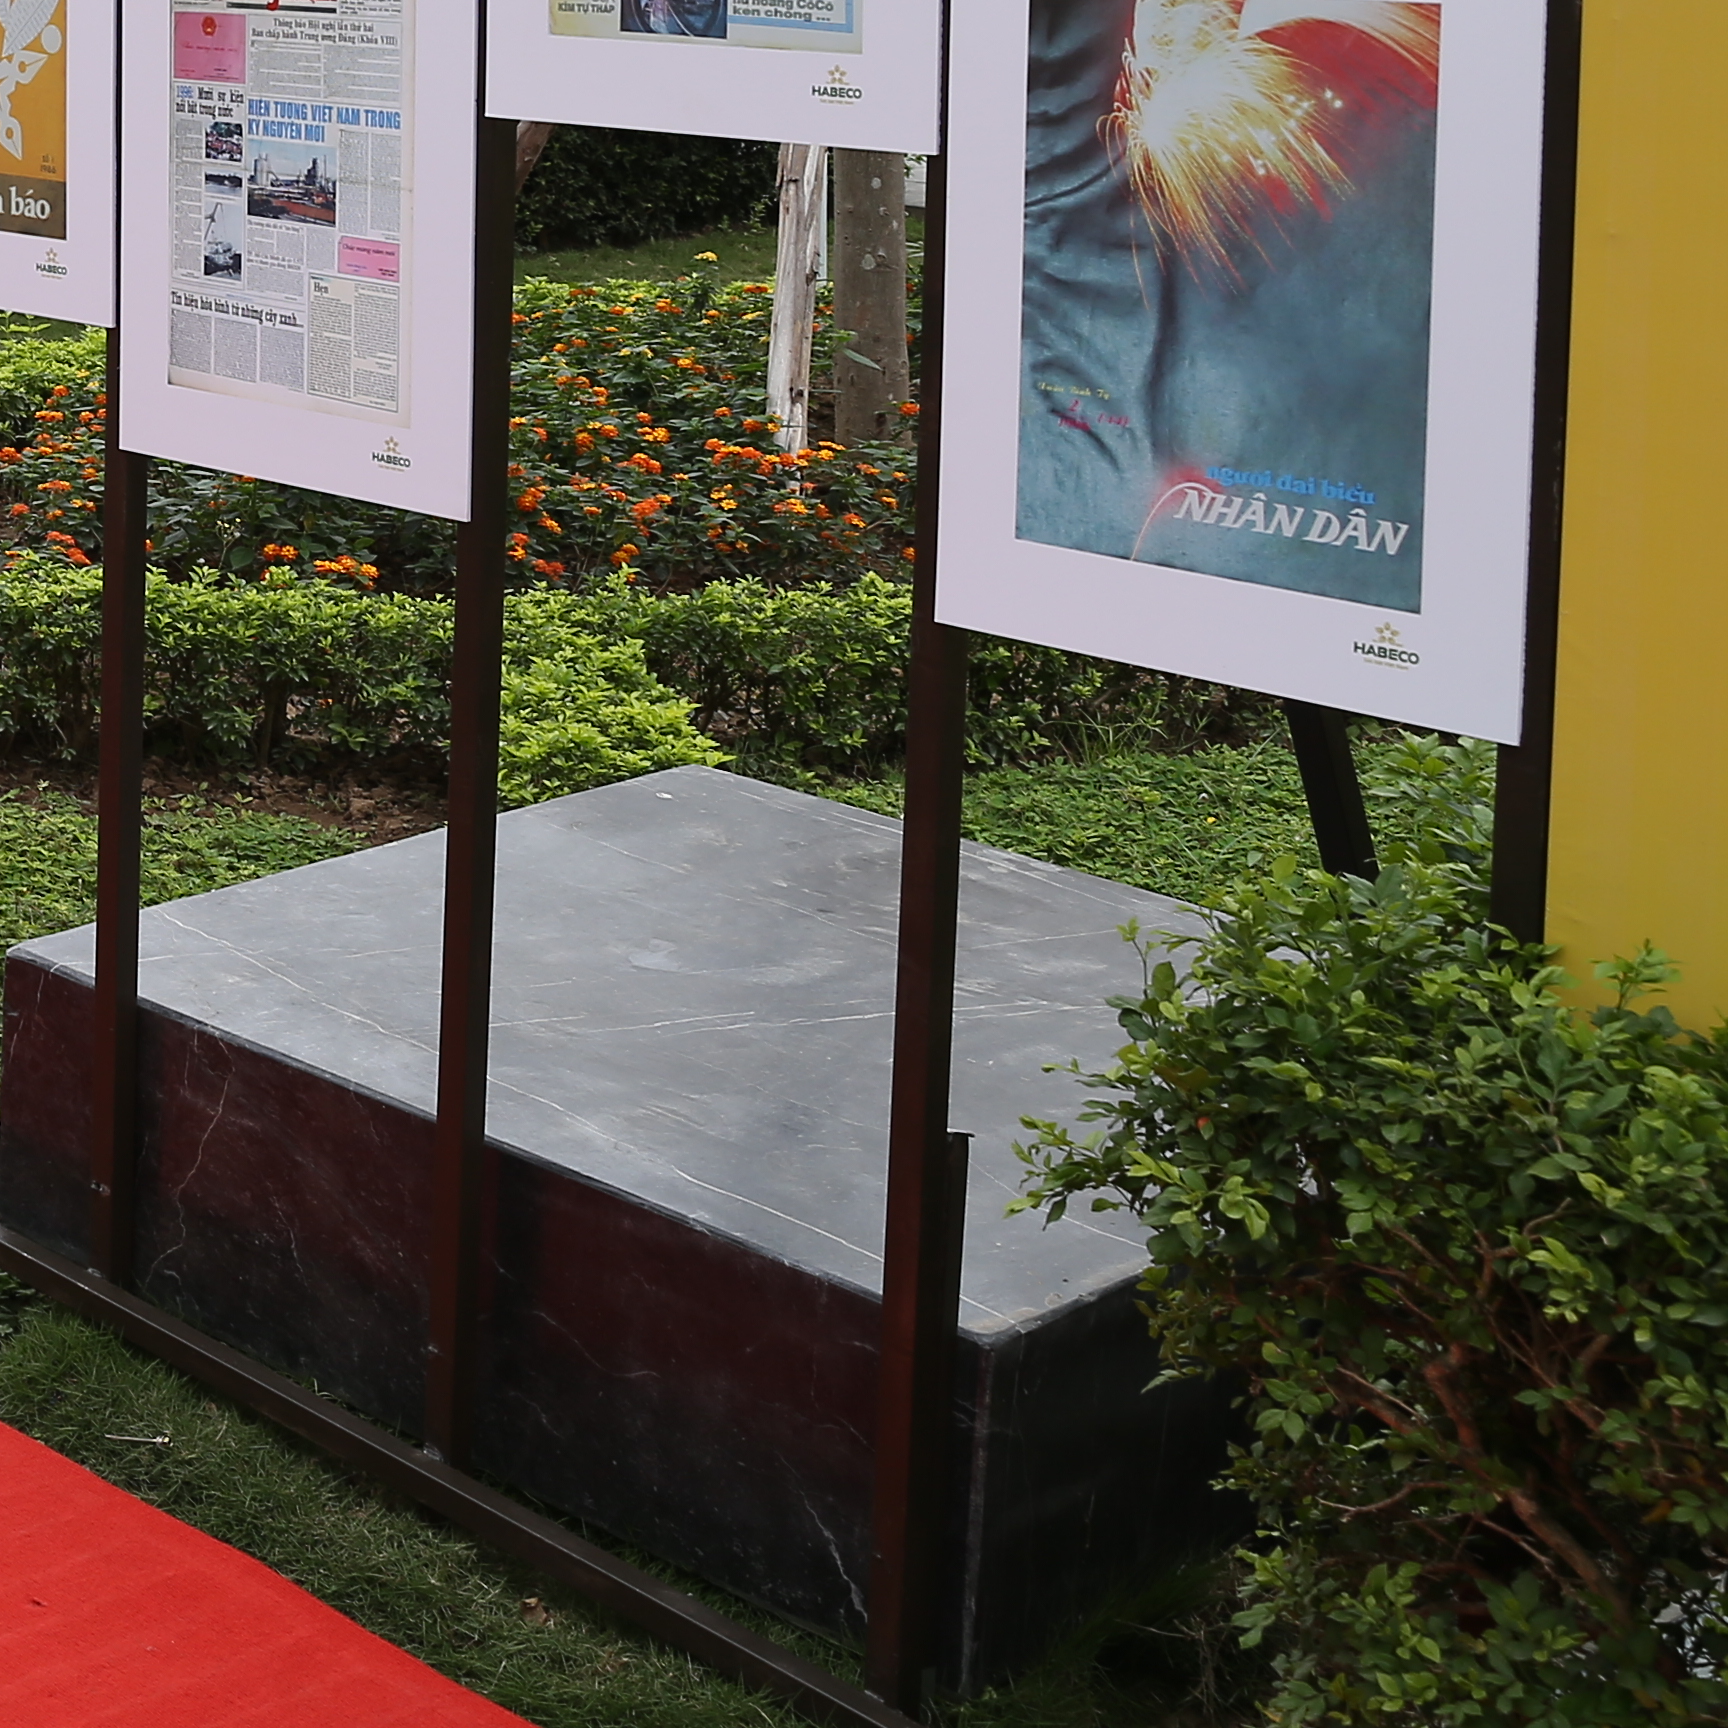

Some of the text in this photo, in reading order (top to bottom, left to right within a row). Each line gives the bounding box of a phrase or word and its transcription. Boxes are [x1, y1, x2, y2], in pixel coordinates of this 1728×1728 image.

[811, 83, 863, 100] HABECO
[335, 107, 362, 127] NAM
[363, 108, 402, 130] TRONG
[8, 186, 51, 221] báo
[35, 262, 68, 276] HABECO
[372, 450, 412, 469] HABECO
[1172, 486, 1411, 557] NHÂN DÂN
[1352, 640, 1421, 667] HABECO
